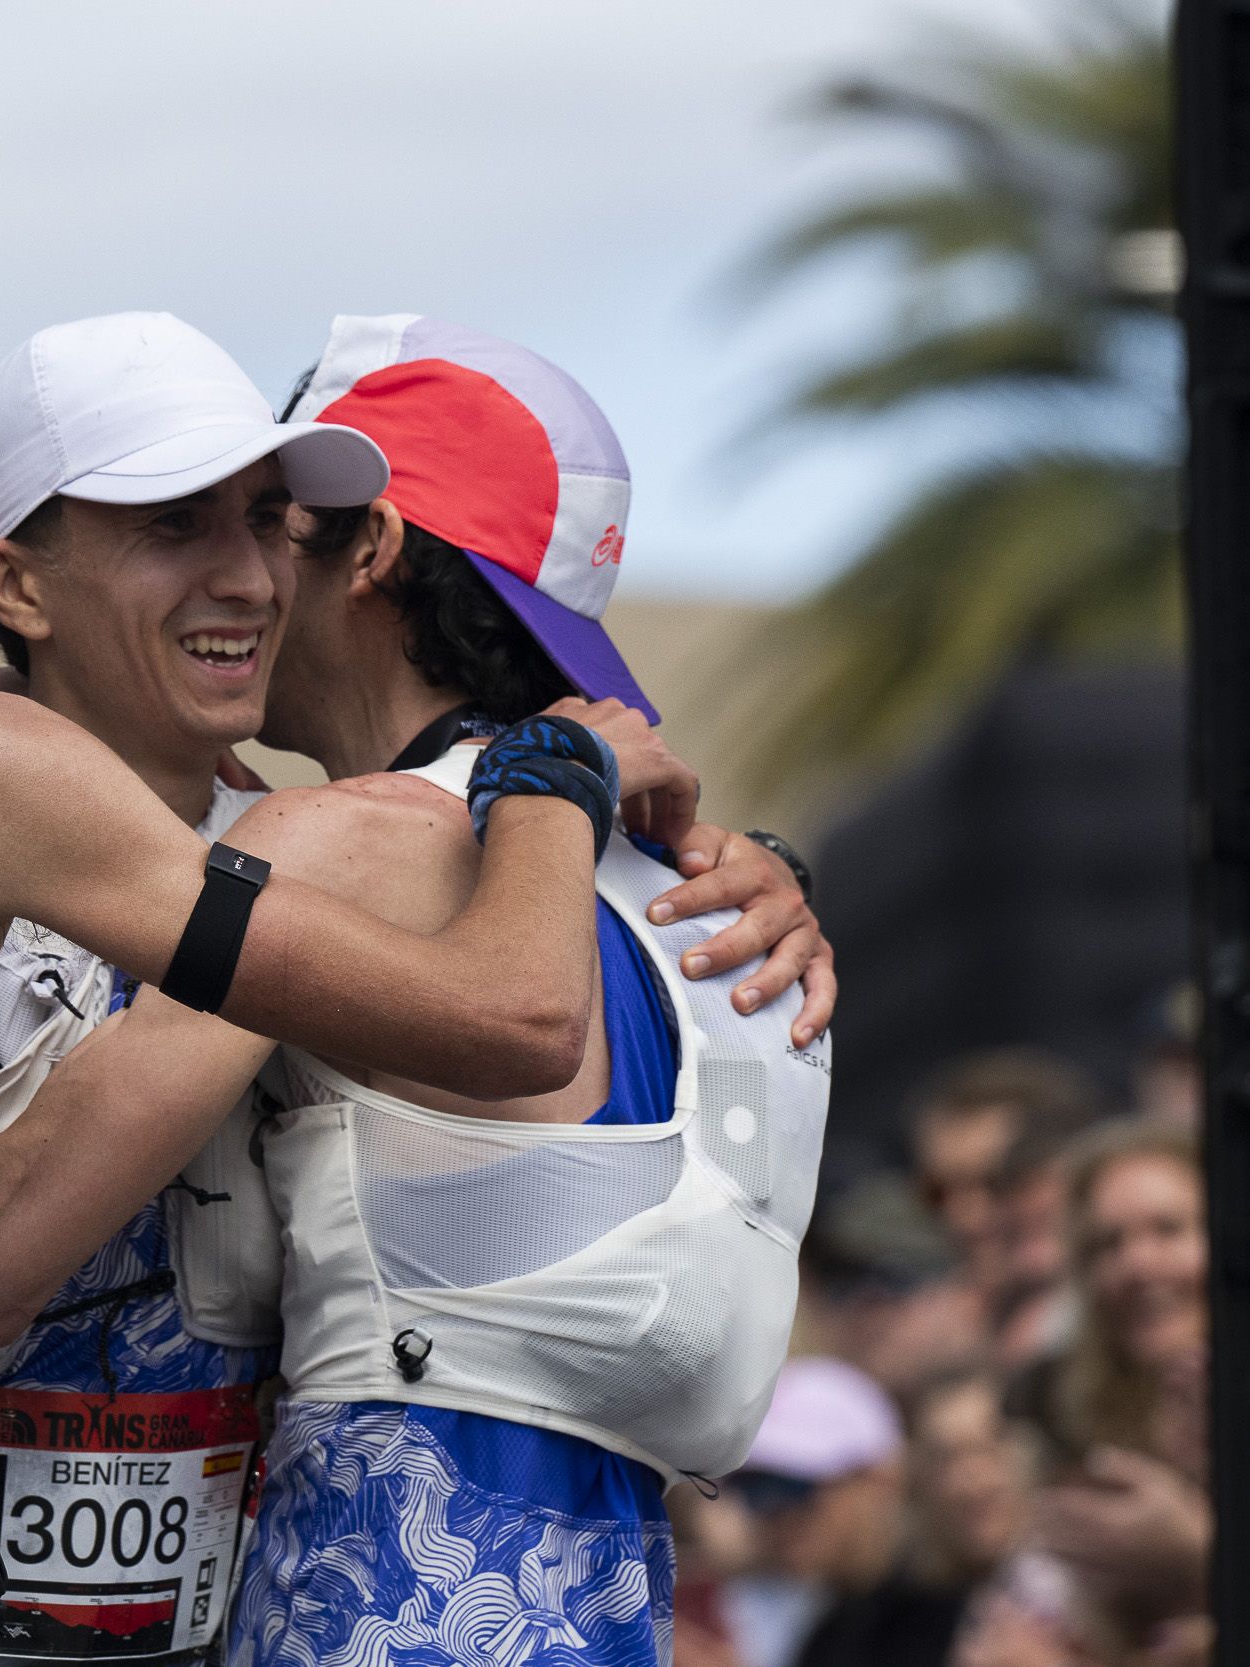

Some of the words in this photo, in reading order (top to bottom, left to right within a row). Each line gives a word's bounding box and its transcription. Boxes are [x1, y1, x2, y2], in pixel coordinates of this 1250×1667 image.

[43, 1400, 146, 1449] TRANS
[151, 1414, 190, 1431] GRAN
[51, 1455, 171, 1486] BENÍTEZ
[6, 1495, 189, 1568] 3008
